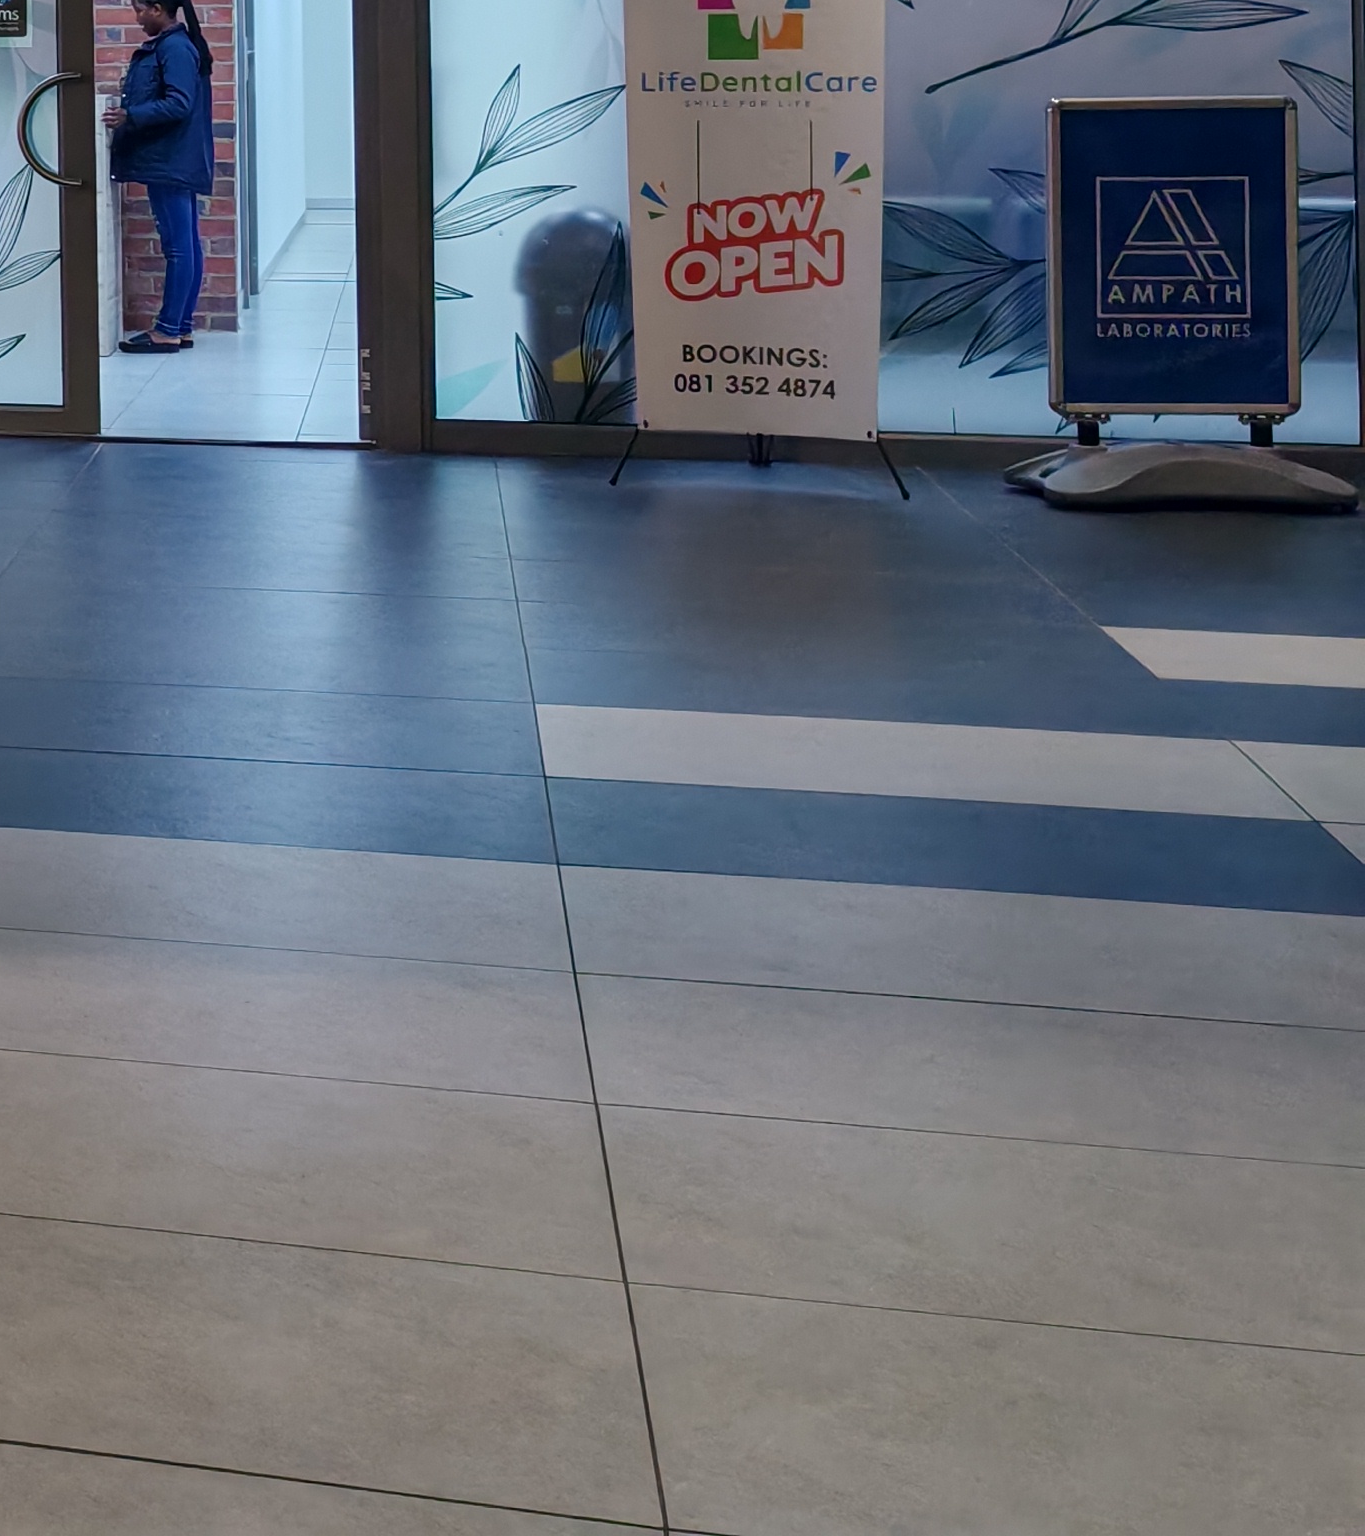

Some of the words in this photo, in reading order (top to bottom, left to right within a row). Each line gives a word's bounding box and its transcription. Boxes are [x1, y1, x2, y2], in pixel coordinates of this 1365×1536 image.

[641, 70, 878, 93] LifeDentalCare
[684, 100, 729, 108] SMILE
[739, 100, 768, 108] FOR
[778, 100, 811, 108] LIFE
[693, 193, 819, 244] NOW
[670, 234, 838, 296] OPEN
[1108, 284, 1243, 304] AMPATH
[1097, 323, 1251, 339] LABORATORIES
[682, 344, 828, 369] BOOKINGS:
[674, 374, 713, 393] 081
[725, 375, 770, 395] 352
[777, 378, 836, 400] 4874
